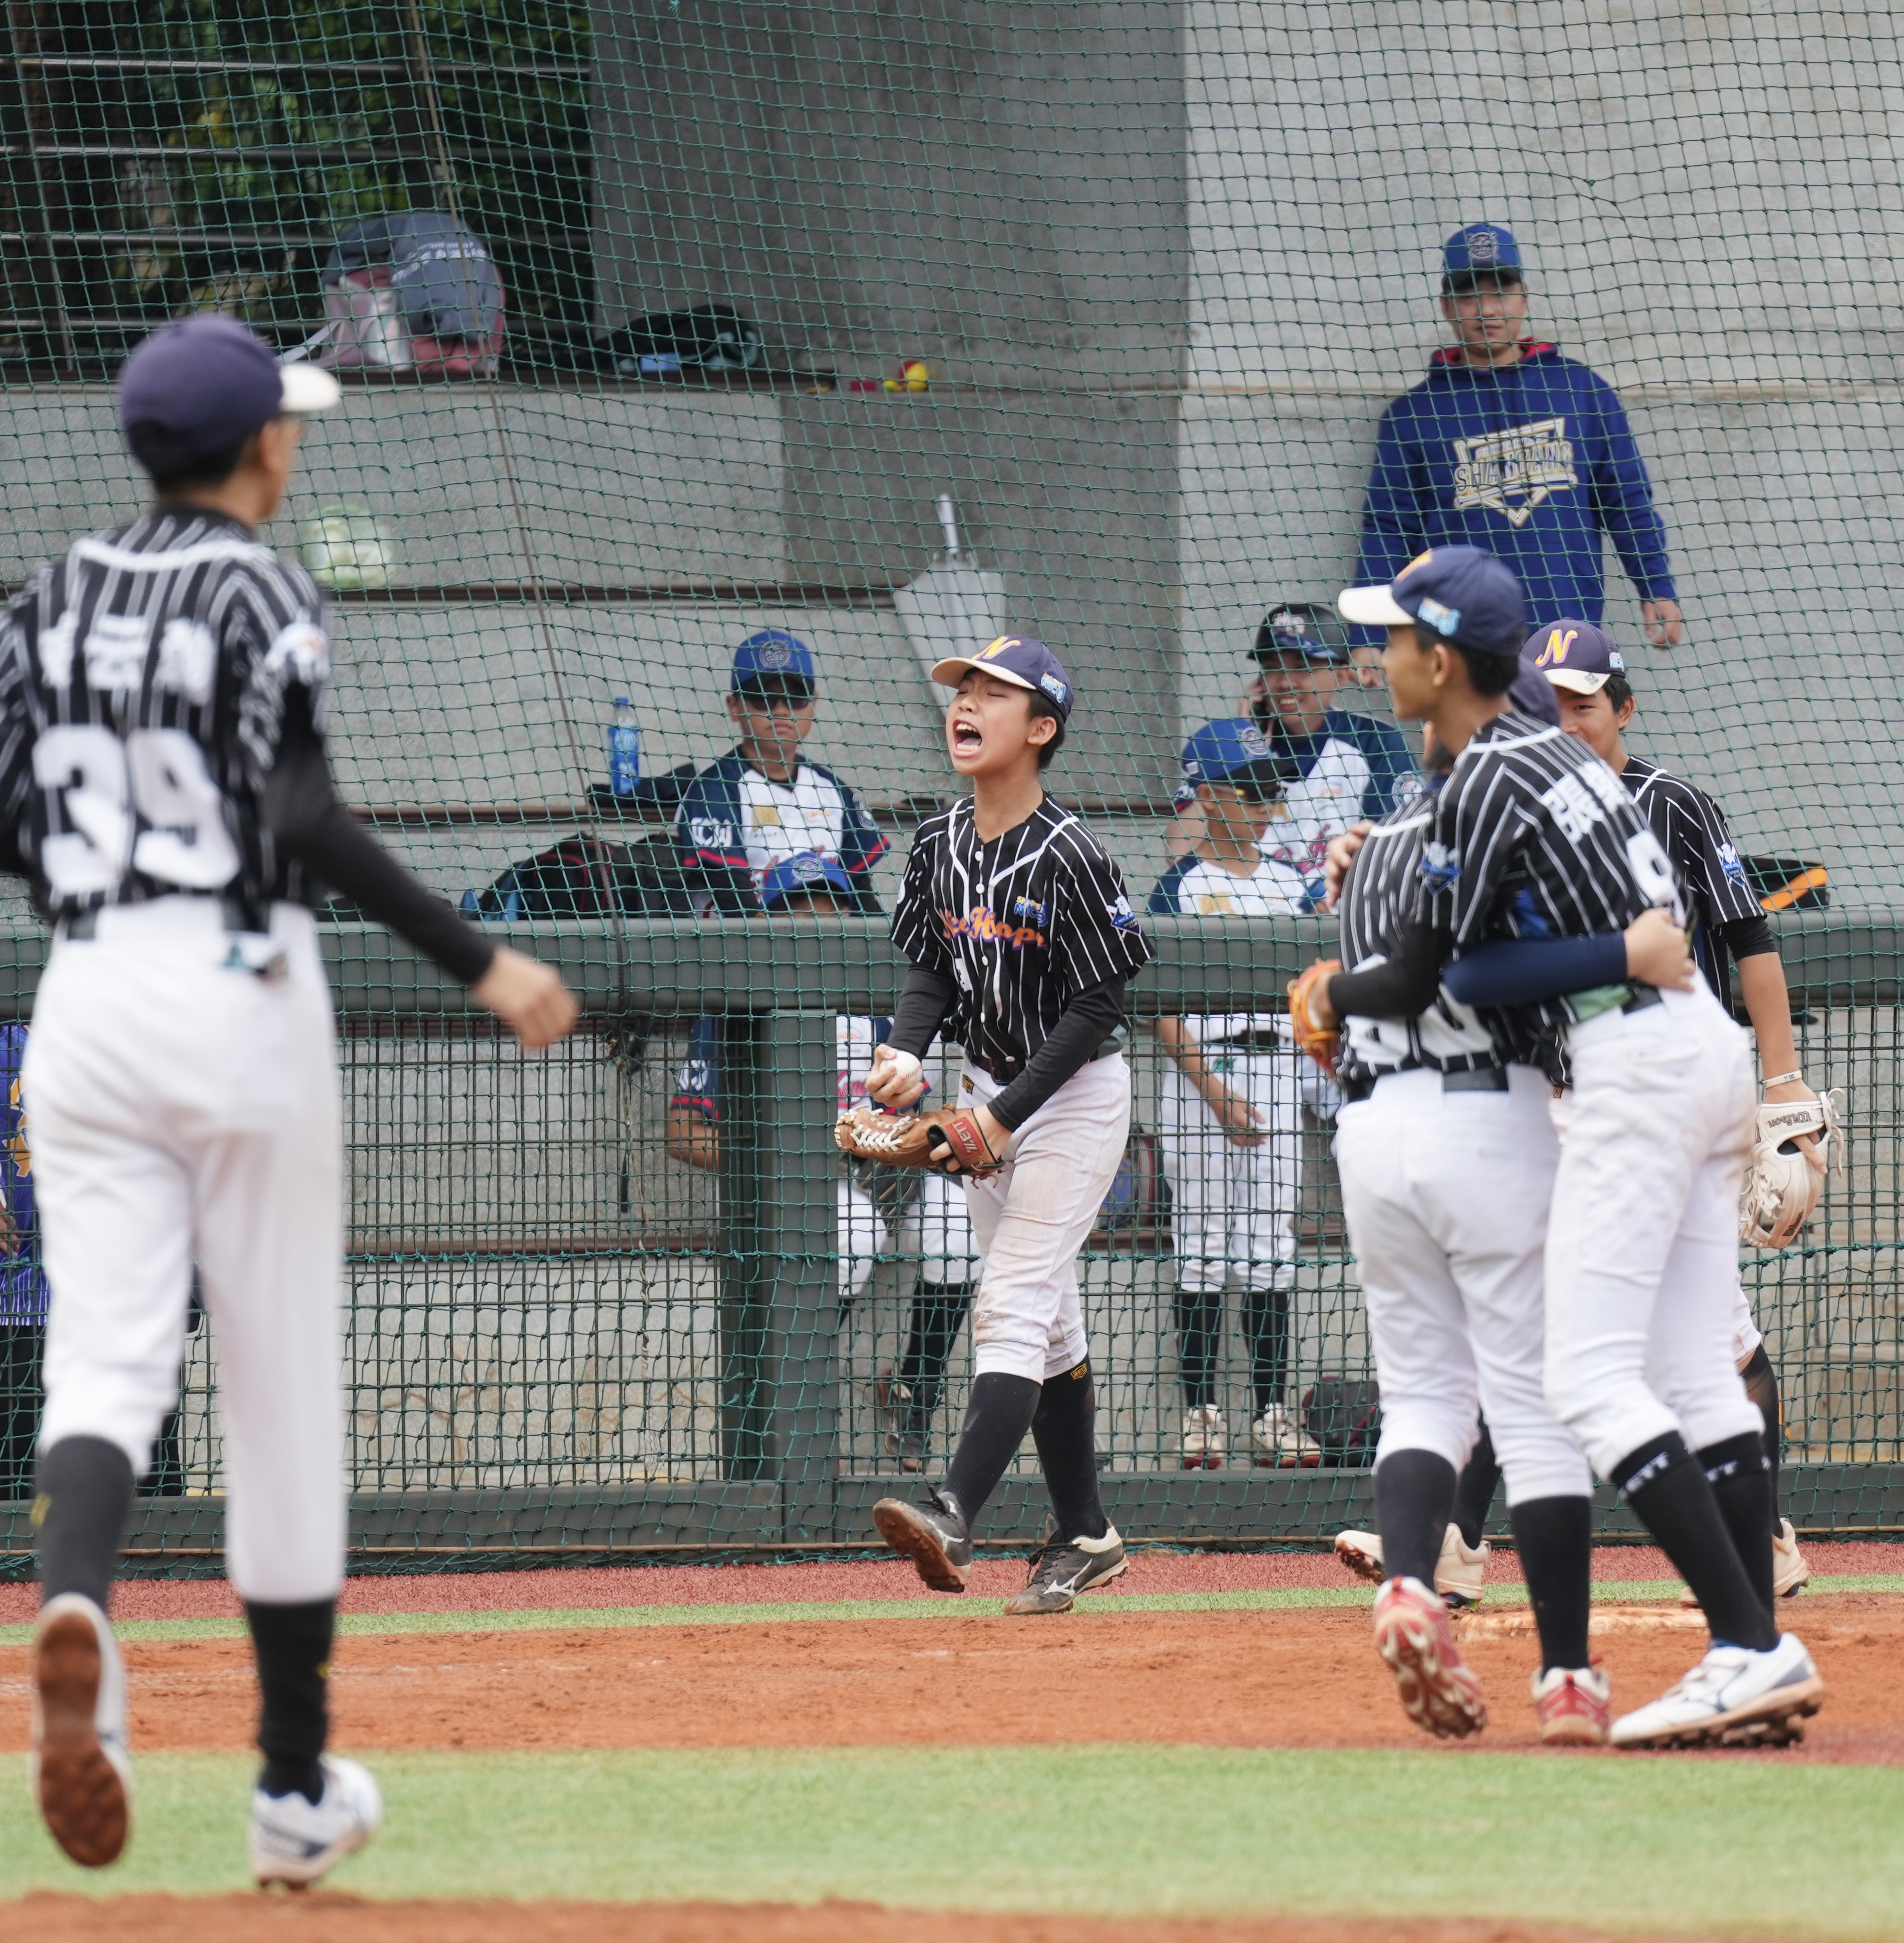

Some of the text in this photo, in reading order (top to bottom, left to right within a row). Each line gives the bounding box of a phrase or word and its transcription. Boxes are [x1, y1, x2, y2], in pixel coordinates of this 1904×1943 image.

[1534, 629, 1578, 668] N
[33, 723, 242, 892] 39
[1766, 1111, 1813, 1128] Wilson
[953, 1121, 979, 1155] ZETT
